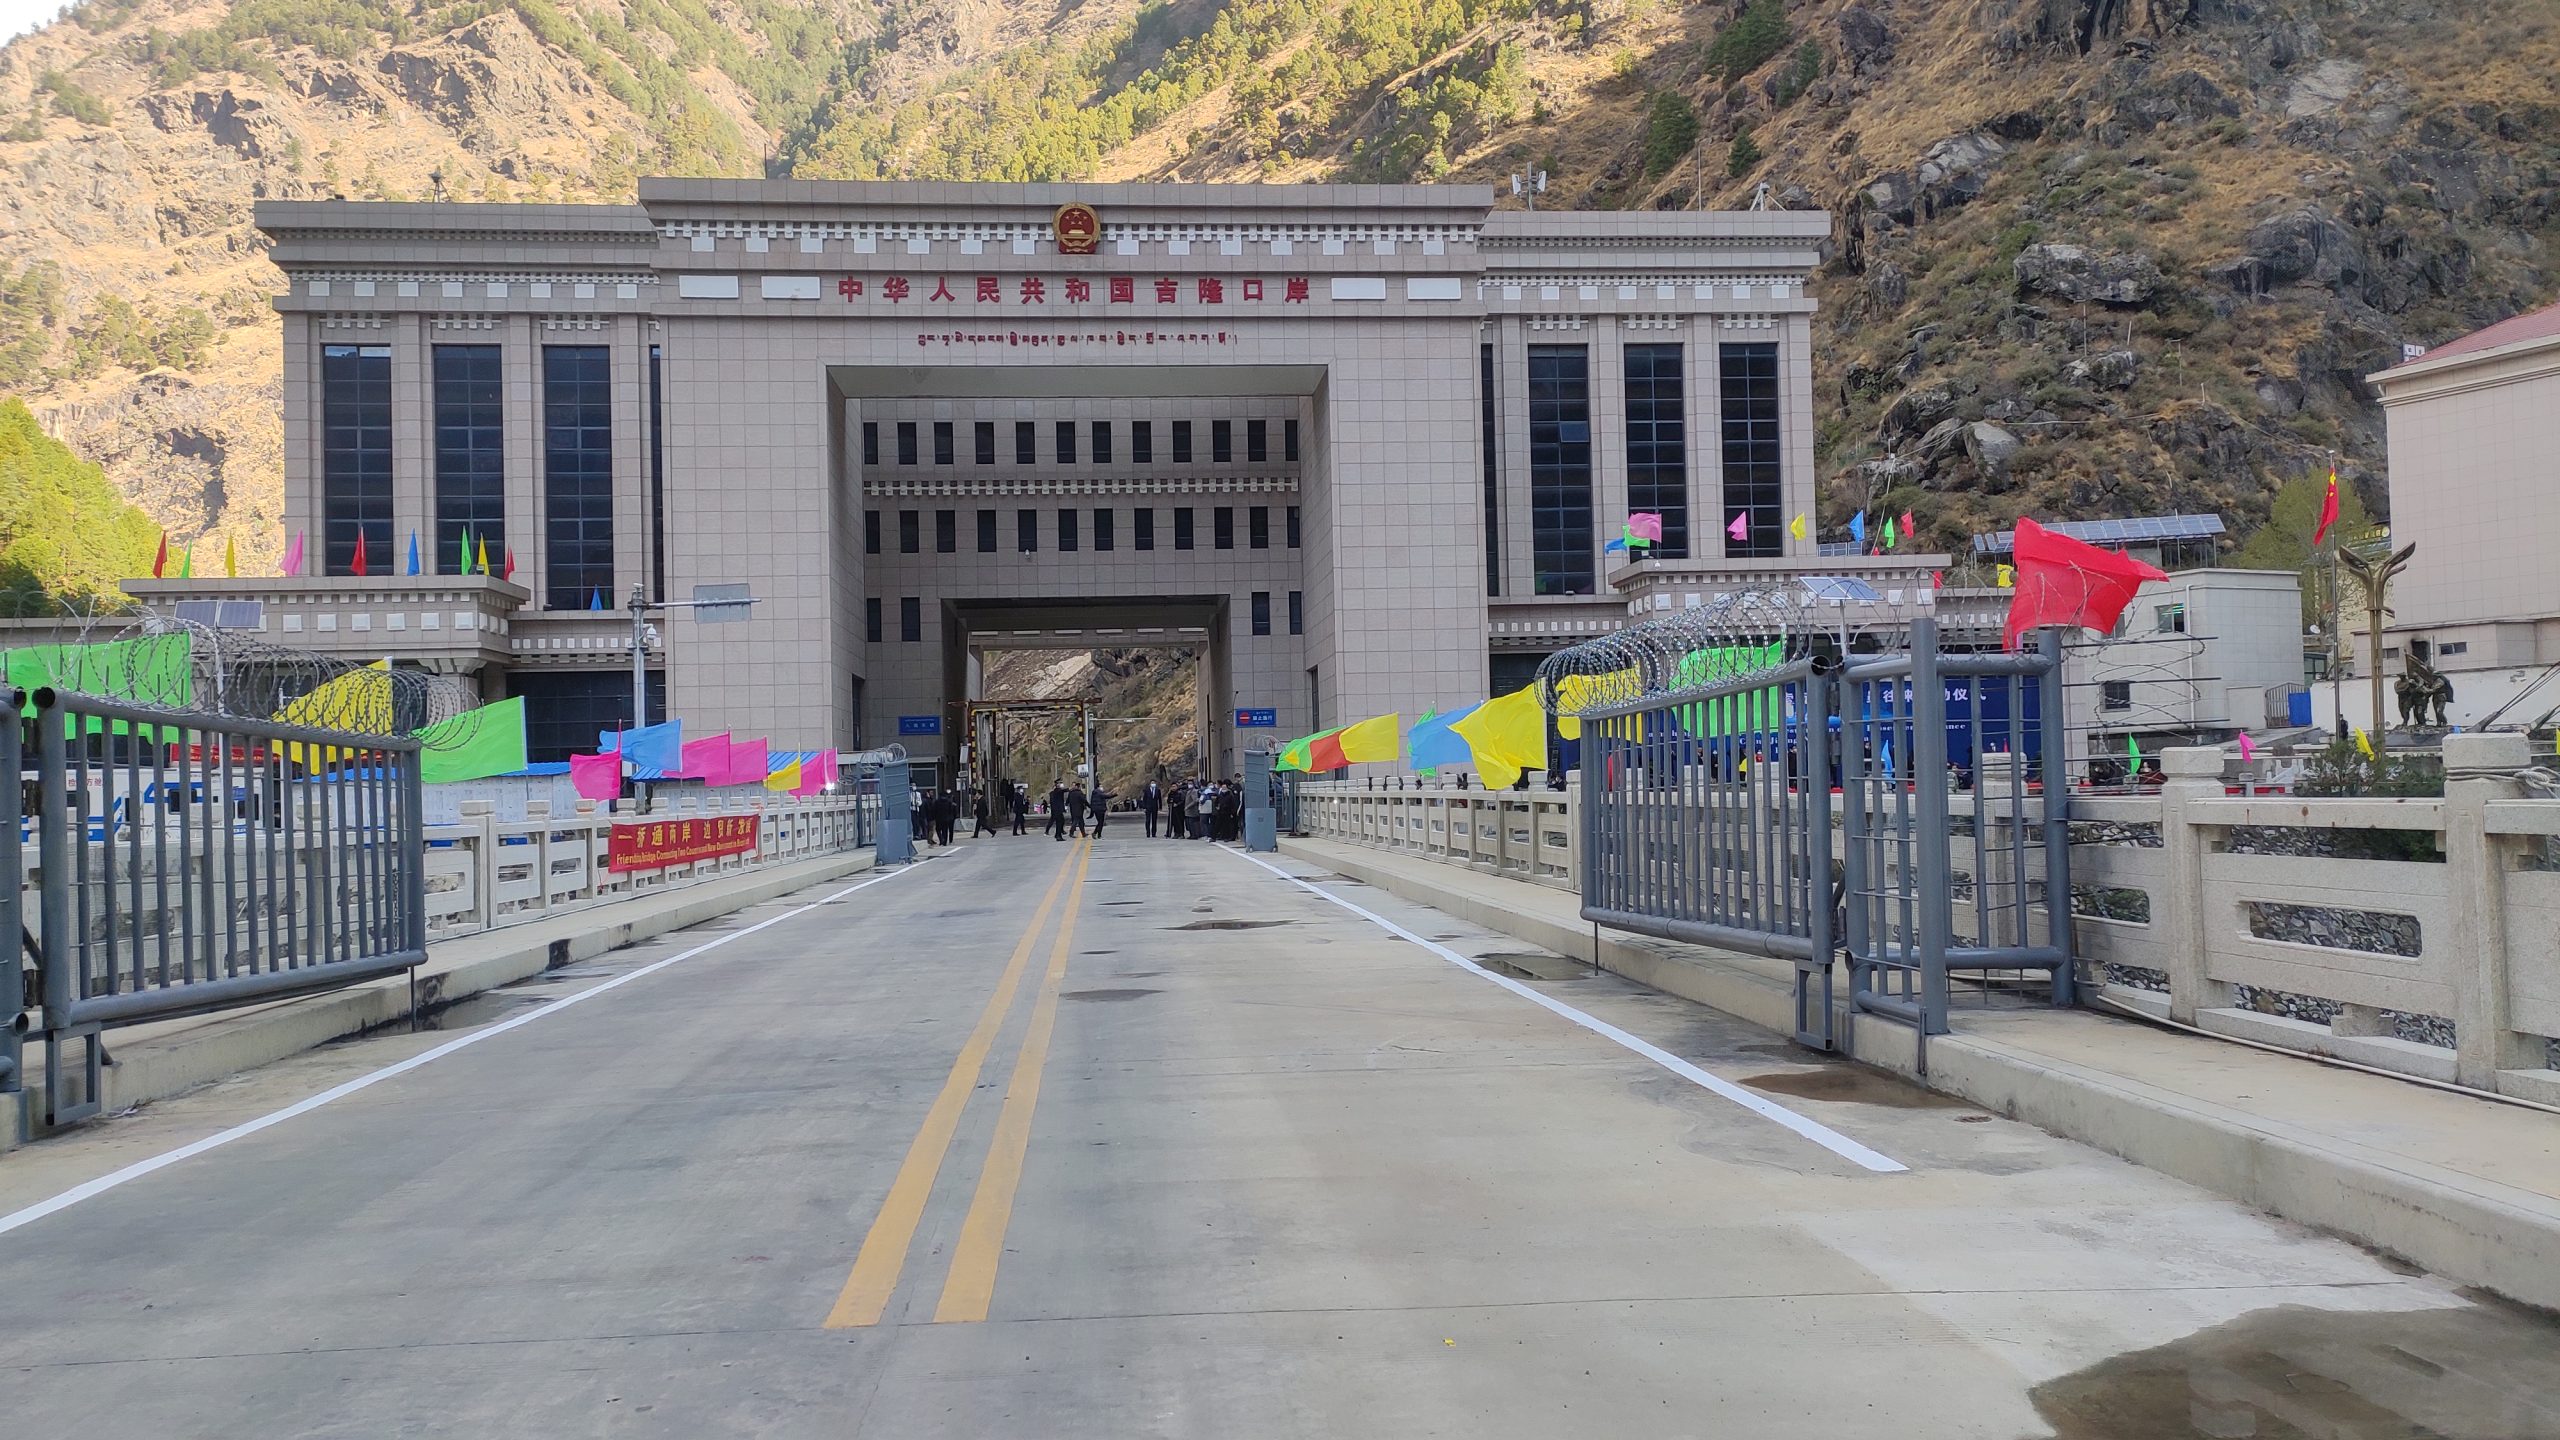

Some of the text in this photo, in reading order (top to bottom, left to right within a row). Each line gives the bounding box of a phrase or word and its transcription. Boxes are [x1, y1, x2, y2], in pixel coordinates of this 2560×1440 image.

[838, 276, 1310, 304] 中华人民共和国吉隆口岸
